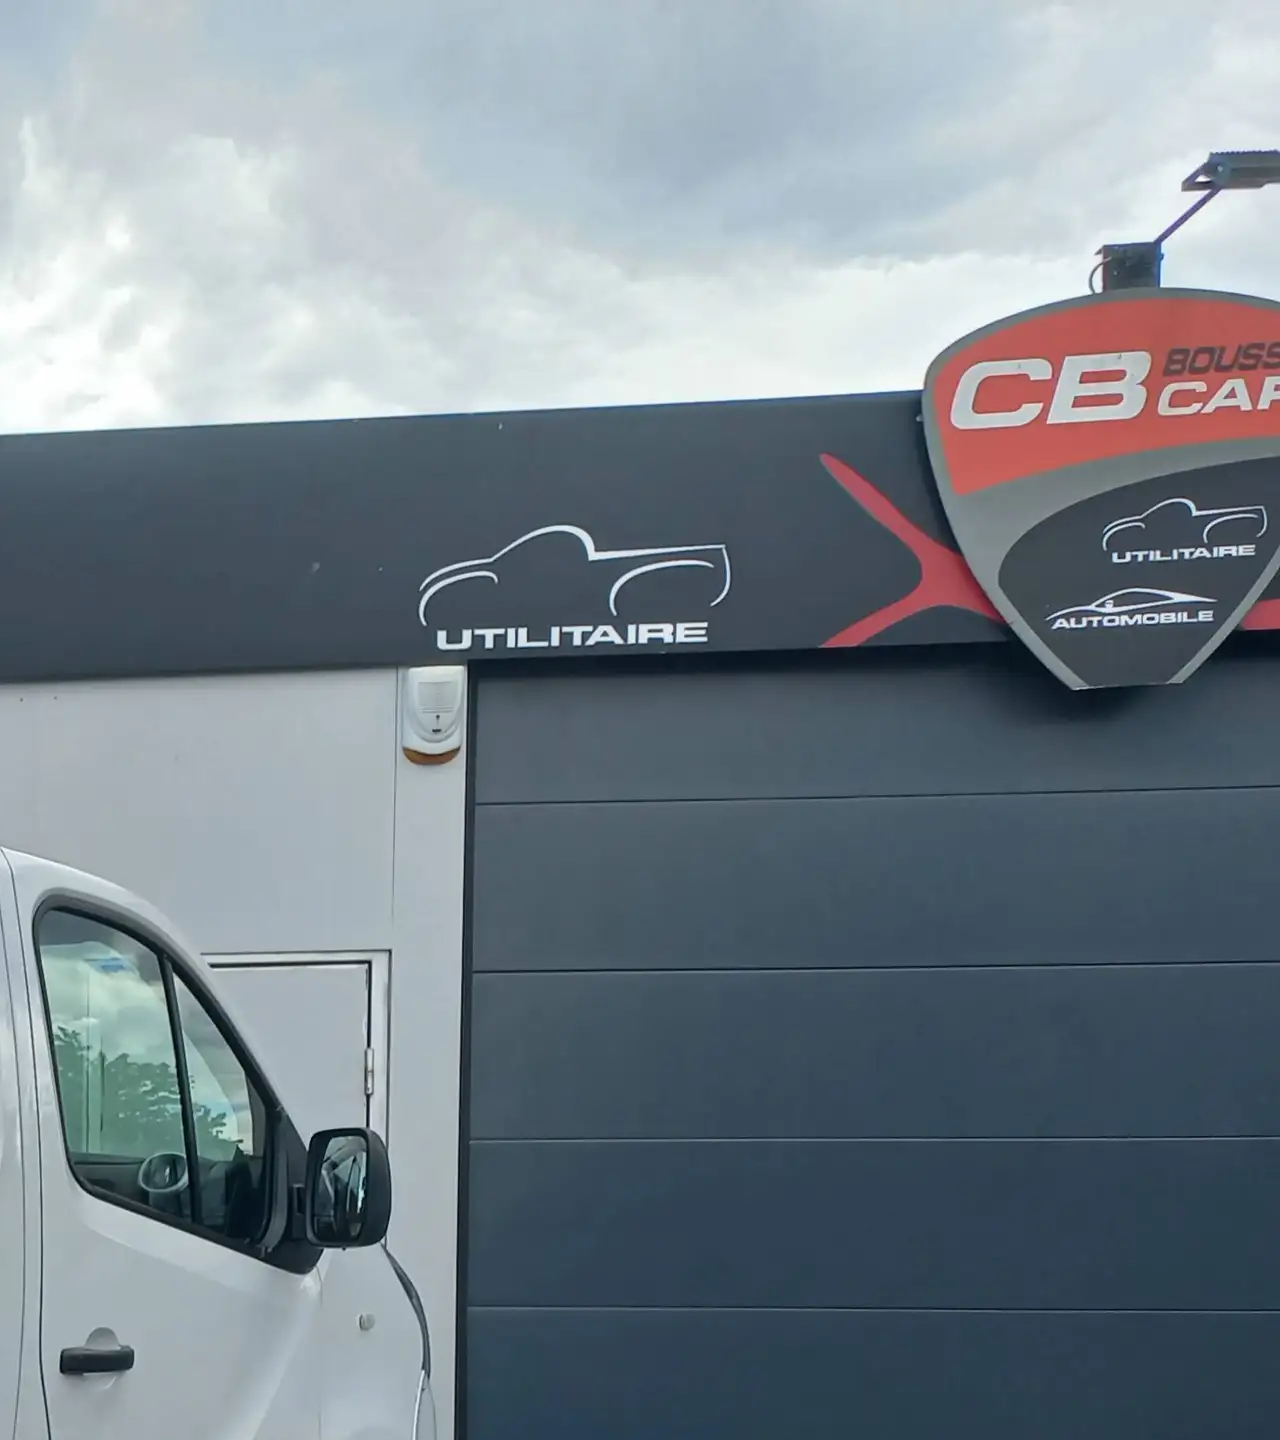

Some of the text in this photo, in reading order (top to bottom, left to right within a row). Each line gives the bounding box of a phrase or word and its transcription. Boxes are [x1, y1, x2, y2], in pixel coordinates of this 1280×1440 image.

[949, 350, 1152, 430] CB
[1111, 544, 1257, 564] UTILITAIRE
[1051, 610, 1215, 630] AUTOMOBILE
[436, 621, 709, 651] UTILITAIRE
